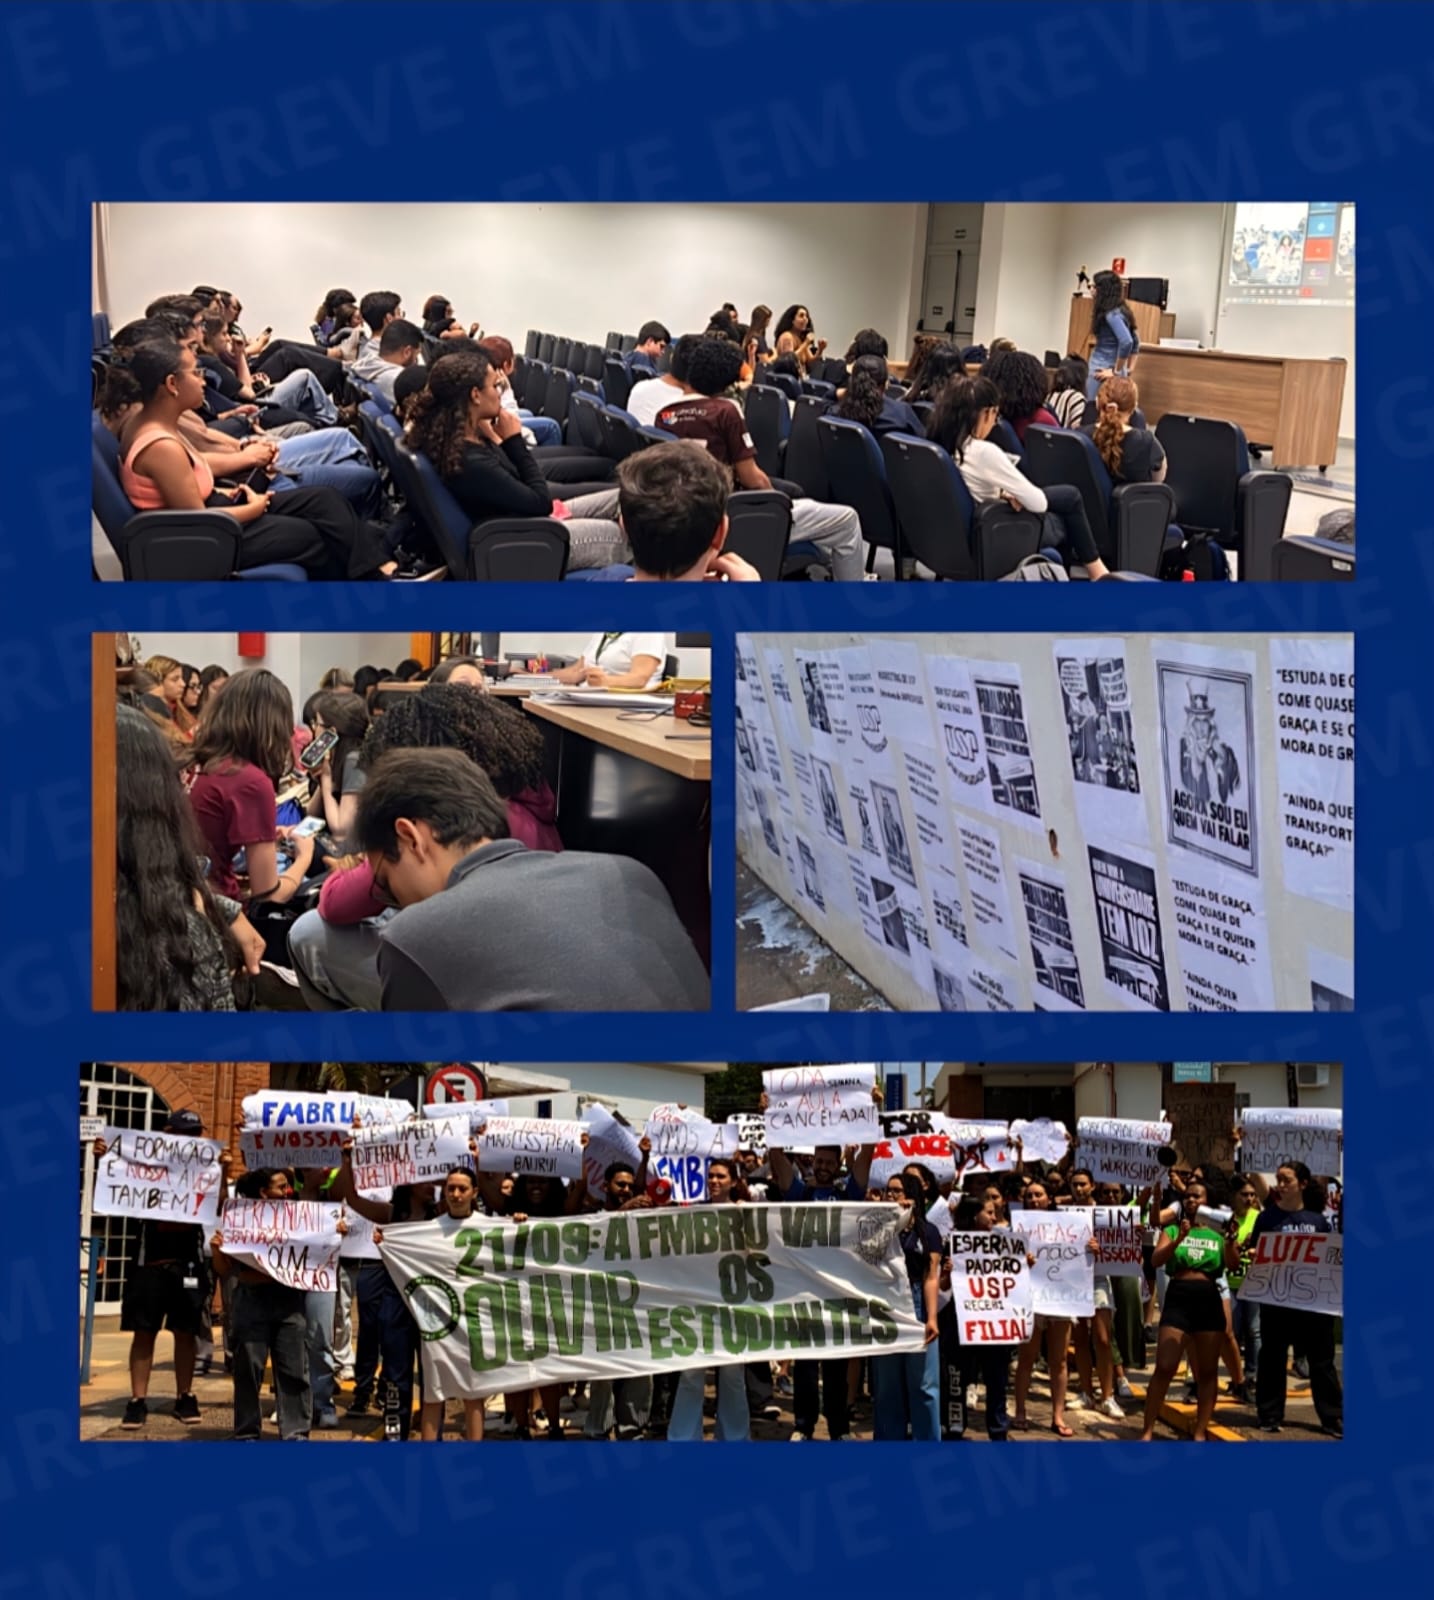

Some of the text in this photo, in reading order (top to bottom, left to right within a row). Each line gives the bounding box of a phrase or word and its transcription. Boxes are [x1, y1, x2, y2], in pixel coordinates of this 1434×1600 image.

[1330, 672, 1346, 688] DE
[1278, 692, 1311, 708] COME
[1279, 715, 1317, 736] GRAÇA
[1321, 719, 1328, 734] E
[1331, 721, 1344, 737] SE
[1281, 739, 1315, 756] MORA
[1318, 743, 1333, 758] DE
[1174, 789, 1248, 831] AGORA SOU EU
[1173, 808, 1250, 850] QUEM VAI FALAR
[1208, 890, 1219, 903] DE
[1174, 896, 1241, 928] COME QUASE DE
[1099, 901, 1130, 946] TEM
[1129, 912, 1160, 963] VOZ
[1176, 913, 1256, 949] GRAÇA E SE QUISER
[1178, 929, 1202, 946] MORA
[1204, 940, 1215, 952] DE
[1214, 984, 1238, 1001] QUER
[262, 1101, 355, 1127] FMBRU
[107, 1134, 122, 1156] A
[273, 1130, 341, 1148] NOSSA
[427, 1142, 437, 1157] A
[708, 1126, 723, 1157] A
[604, 1211, 631, 1261] A
[637, 1207, 769, 1259] FMBRU
[780, 1207, 842, 1247] VAI
[952, 1234, 1026, 1256] ESPERAVA
[1255, 1235, 1327, 1265] LUTE
[966, 1256, 1021, 1275] PADRÃO
[718, 1252, 774, 1304] OS
[968, 1277, 1016, 1299] USP
[1245, 1264, 1319, 1305] SUS
[464, 1270, 643, 1372] OUVIR
[648, 1297, 898, 1359] ESTUDANTES
[965, 1319, 1029, 1341] FILIAL
